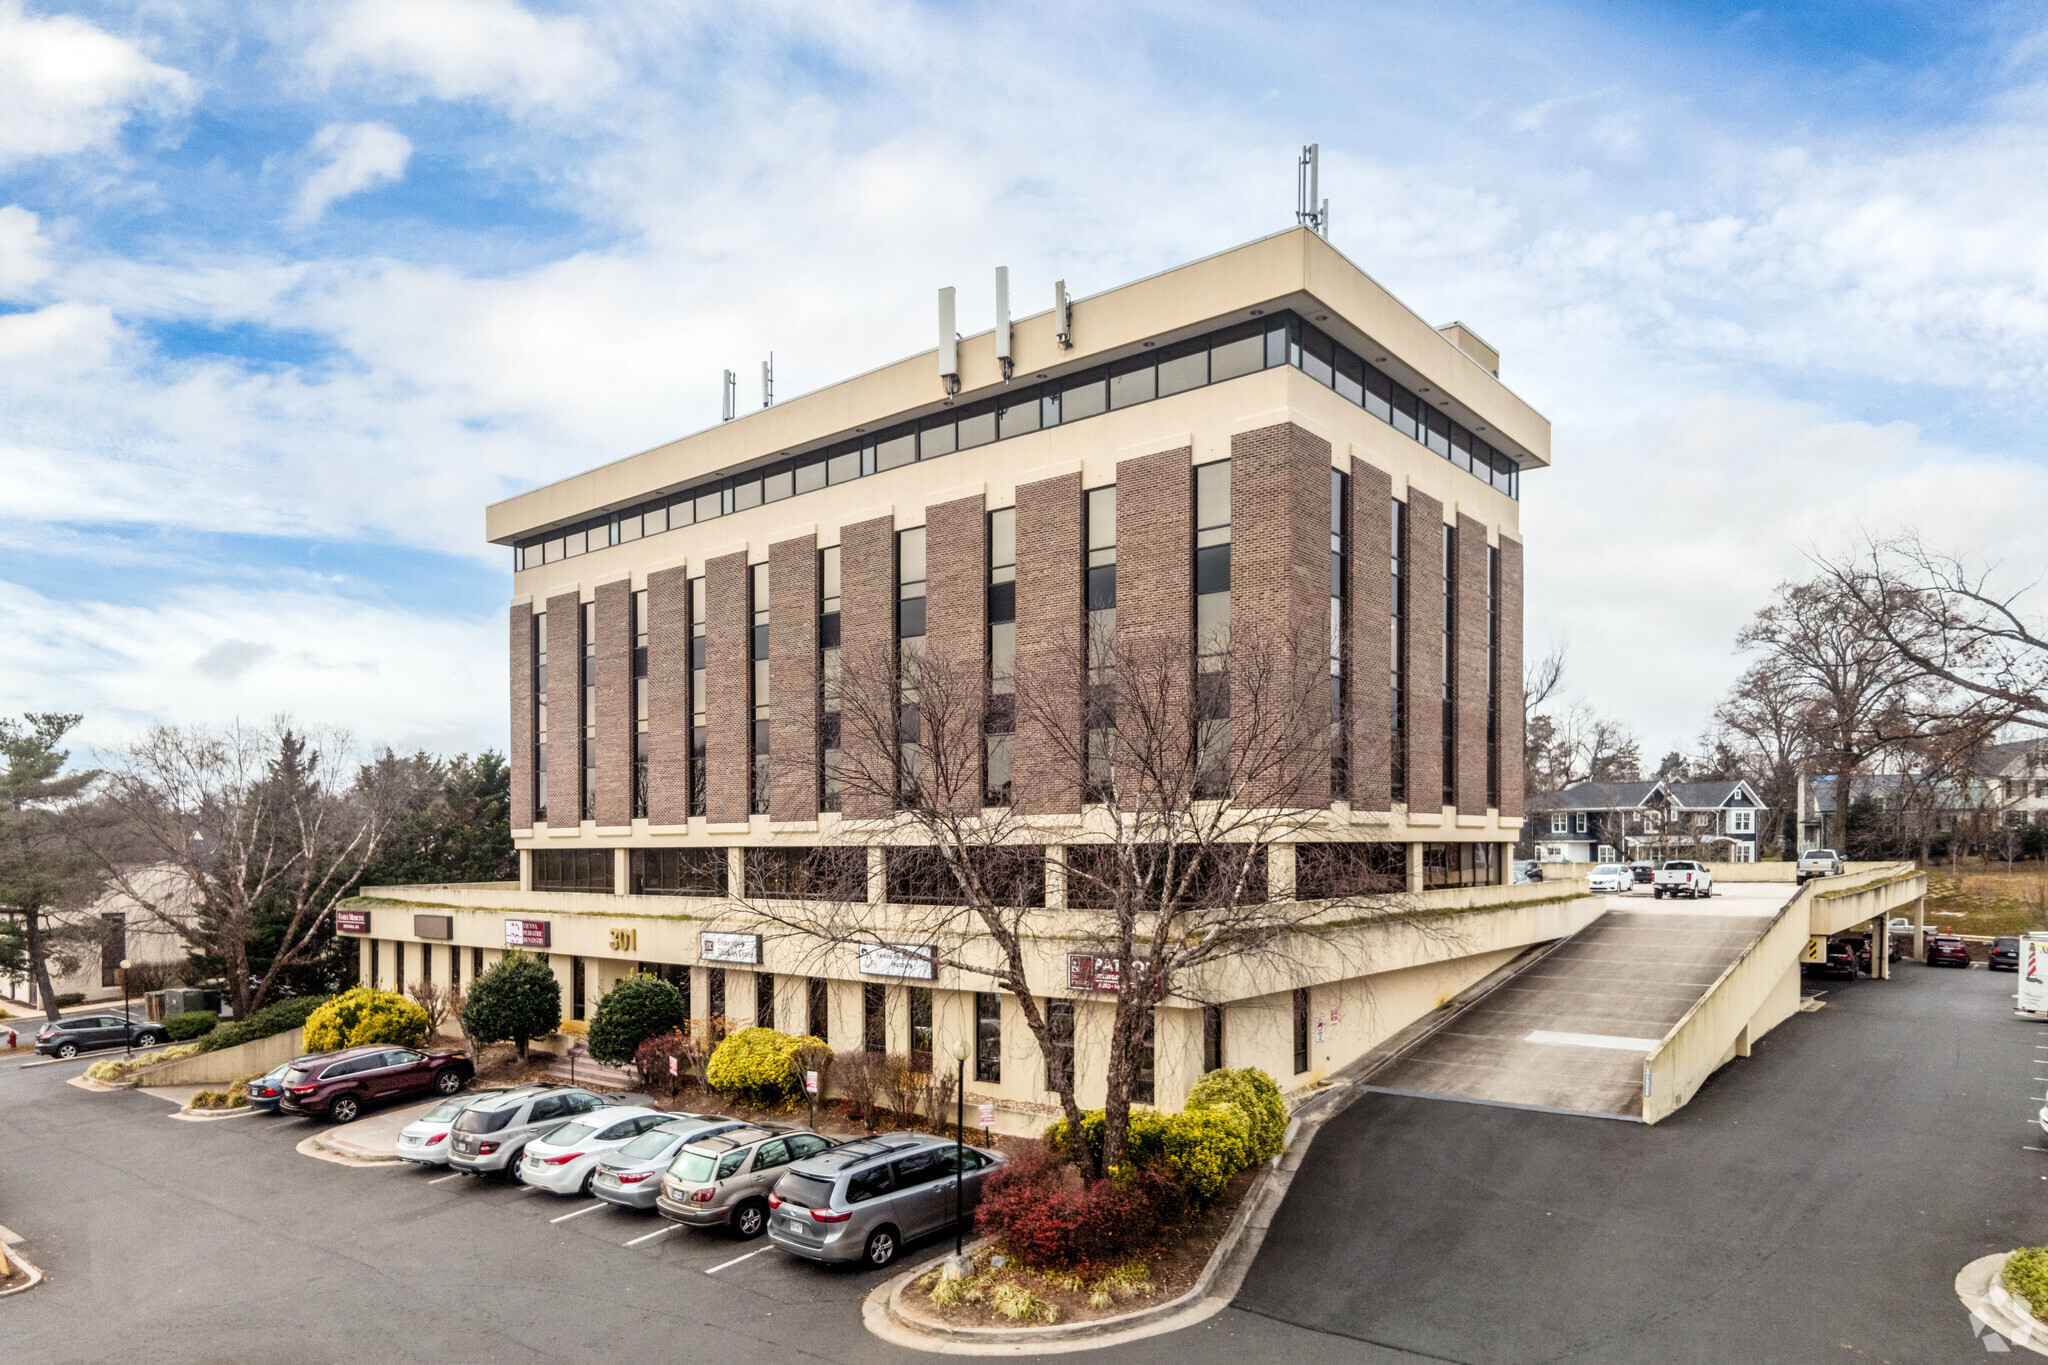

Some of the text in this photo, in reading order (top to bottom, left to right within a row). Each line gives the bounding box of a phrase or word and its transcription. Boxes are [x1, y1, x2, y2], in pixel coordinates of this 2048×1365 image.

[523, 922, 538, 930] VIENNA
[523, 937, 544, 945] DENTISTRY
[609, 928, 636, 951] 301
